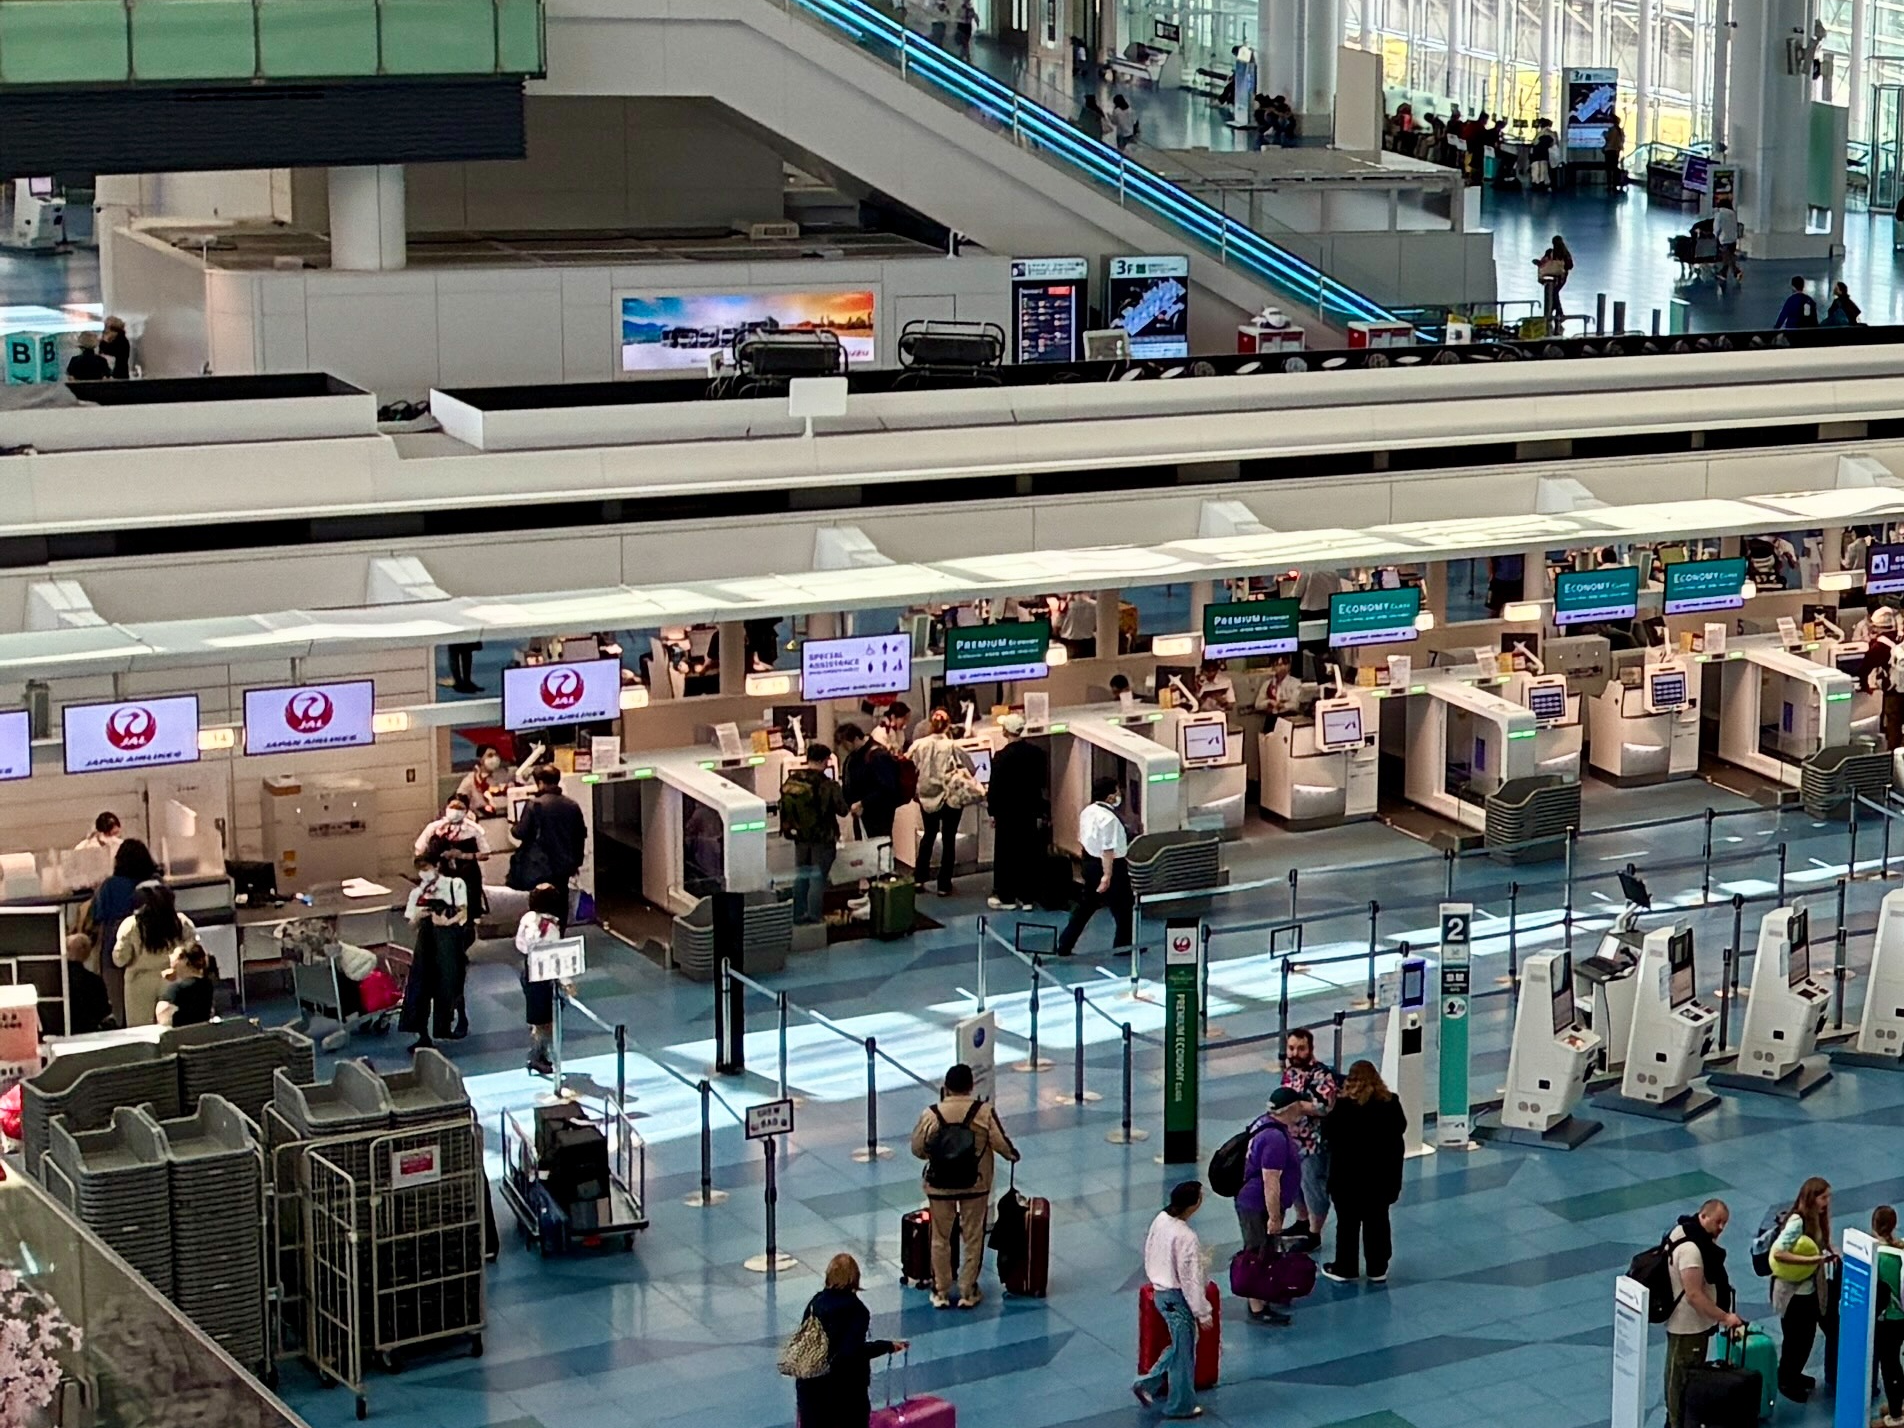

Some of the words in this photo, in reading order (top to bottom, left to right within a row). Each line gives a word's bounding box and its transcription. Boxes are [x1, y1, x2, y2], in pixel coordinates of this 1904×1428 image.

[13, 342, 31, 364] B
[44, 342, 55, 363] B
[1428, 650, 1438, 667] 7
[552, 696, 576, 706] JAL
[298, 719, 324, 730] JAL
[120, 735, 147, 747] JAL
[85, 756, 124, 767] JAPAN
[1447, 917, 1464, 941] 2
